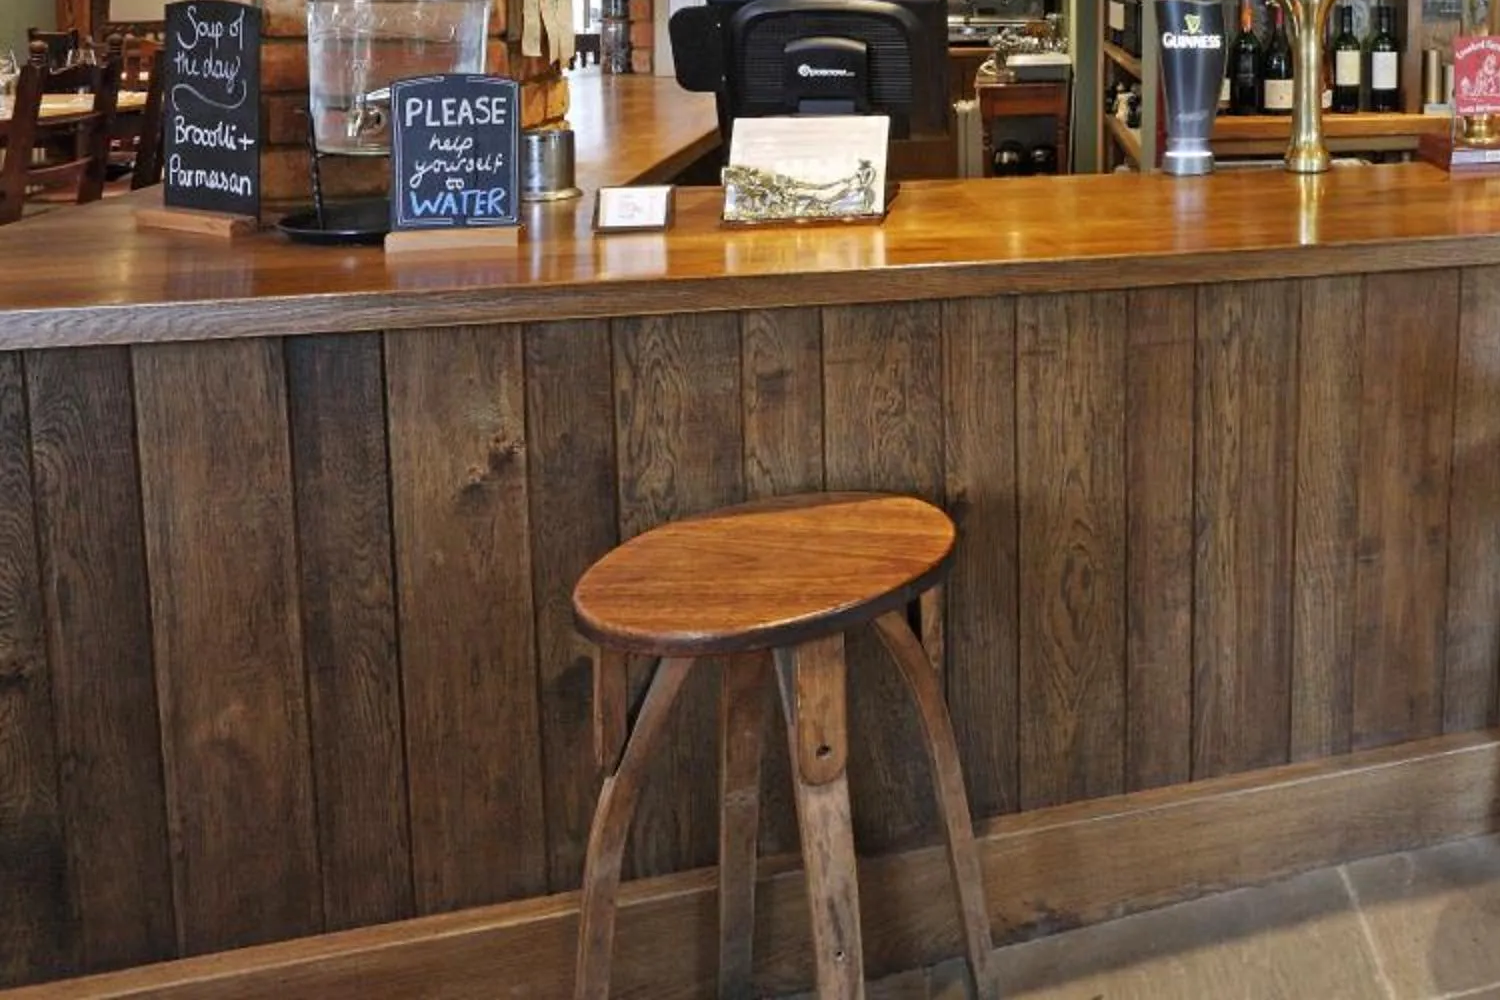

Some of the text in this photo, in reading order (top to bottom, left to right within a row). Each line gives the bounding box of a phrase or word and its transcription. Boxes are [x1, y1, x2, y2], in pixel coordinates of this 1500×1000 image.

[176, 5, 245, 50] Soup of
[1162, 31, 1221, 49] GUINNESS
[173, 49, 240, 94] the day
[405, 96, 507, 127] PLEASE
[429, 132, 473, 158] help
[409, 153, 503, 189] yourself
[445, 176, 465, 190] to
[409, 187, 506, 216] WATER
